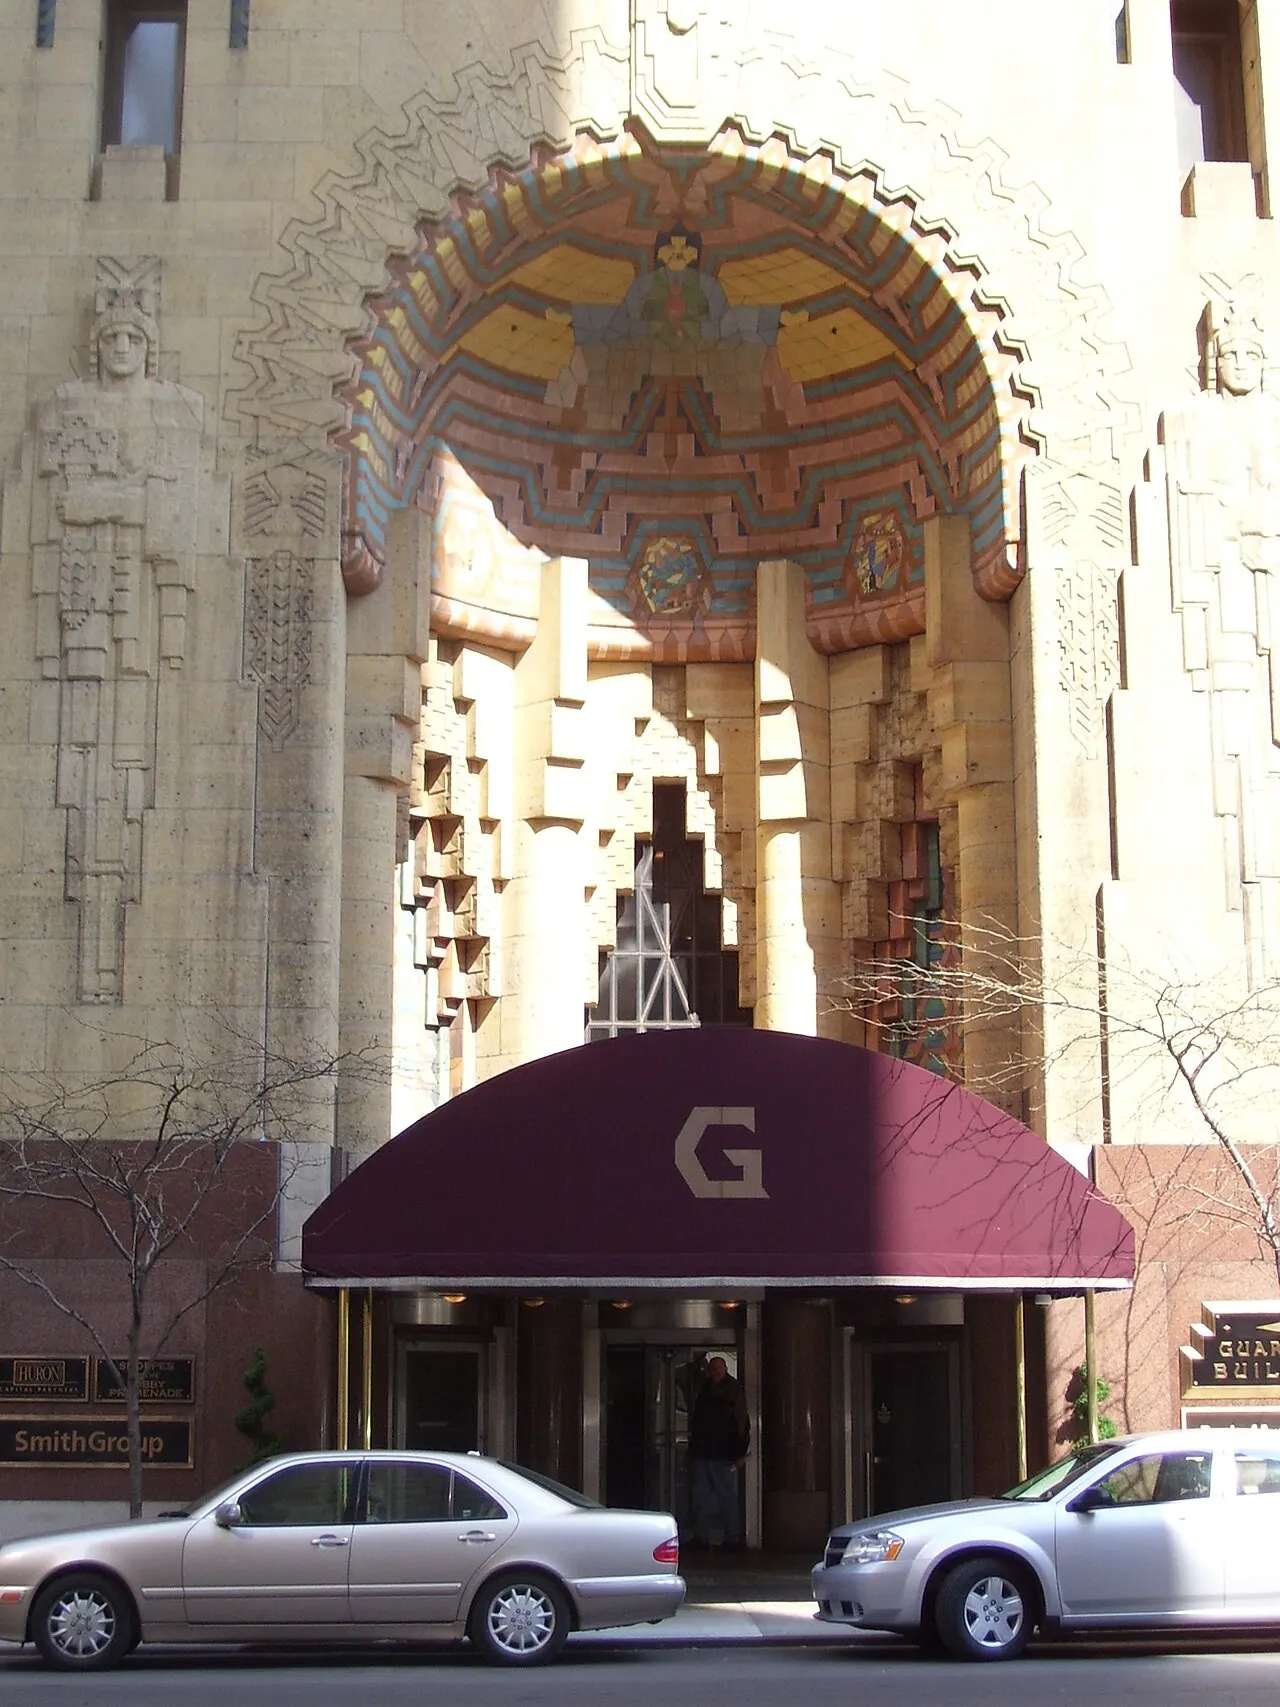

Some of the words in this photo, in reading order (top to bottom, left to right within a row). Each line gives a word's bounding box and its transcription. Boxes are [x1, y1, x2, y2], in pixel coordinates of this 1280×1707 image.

[674, 1106, 770, 1199] G
[18, 1365, 60, 1381] HURON
[1213, 1362, 1280, 1379] BUIL
